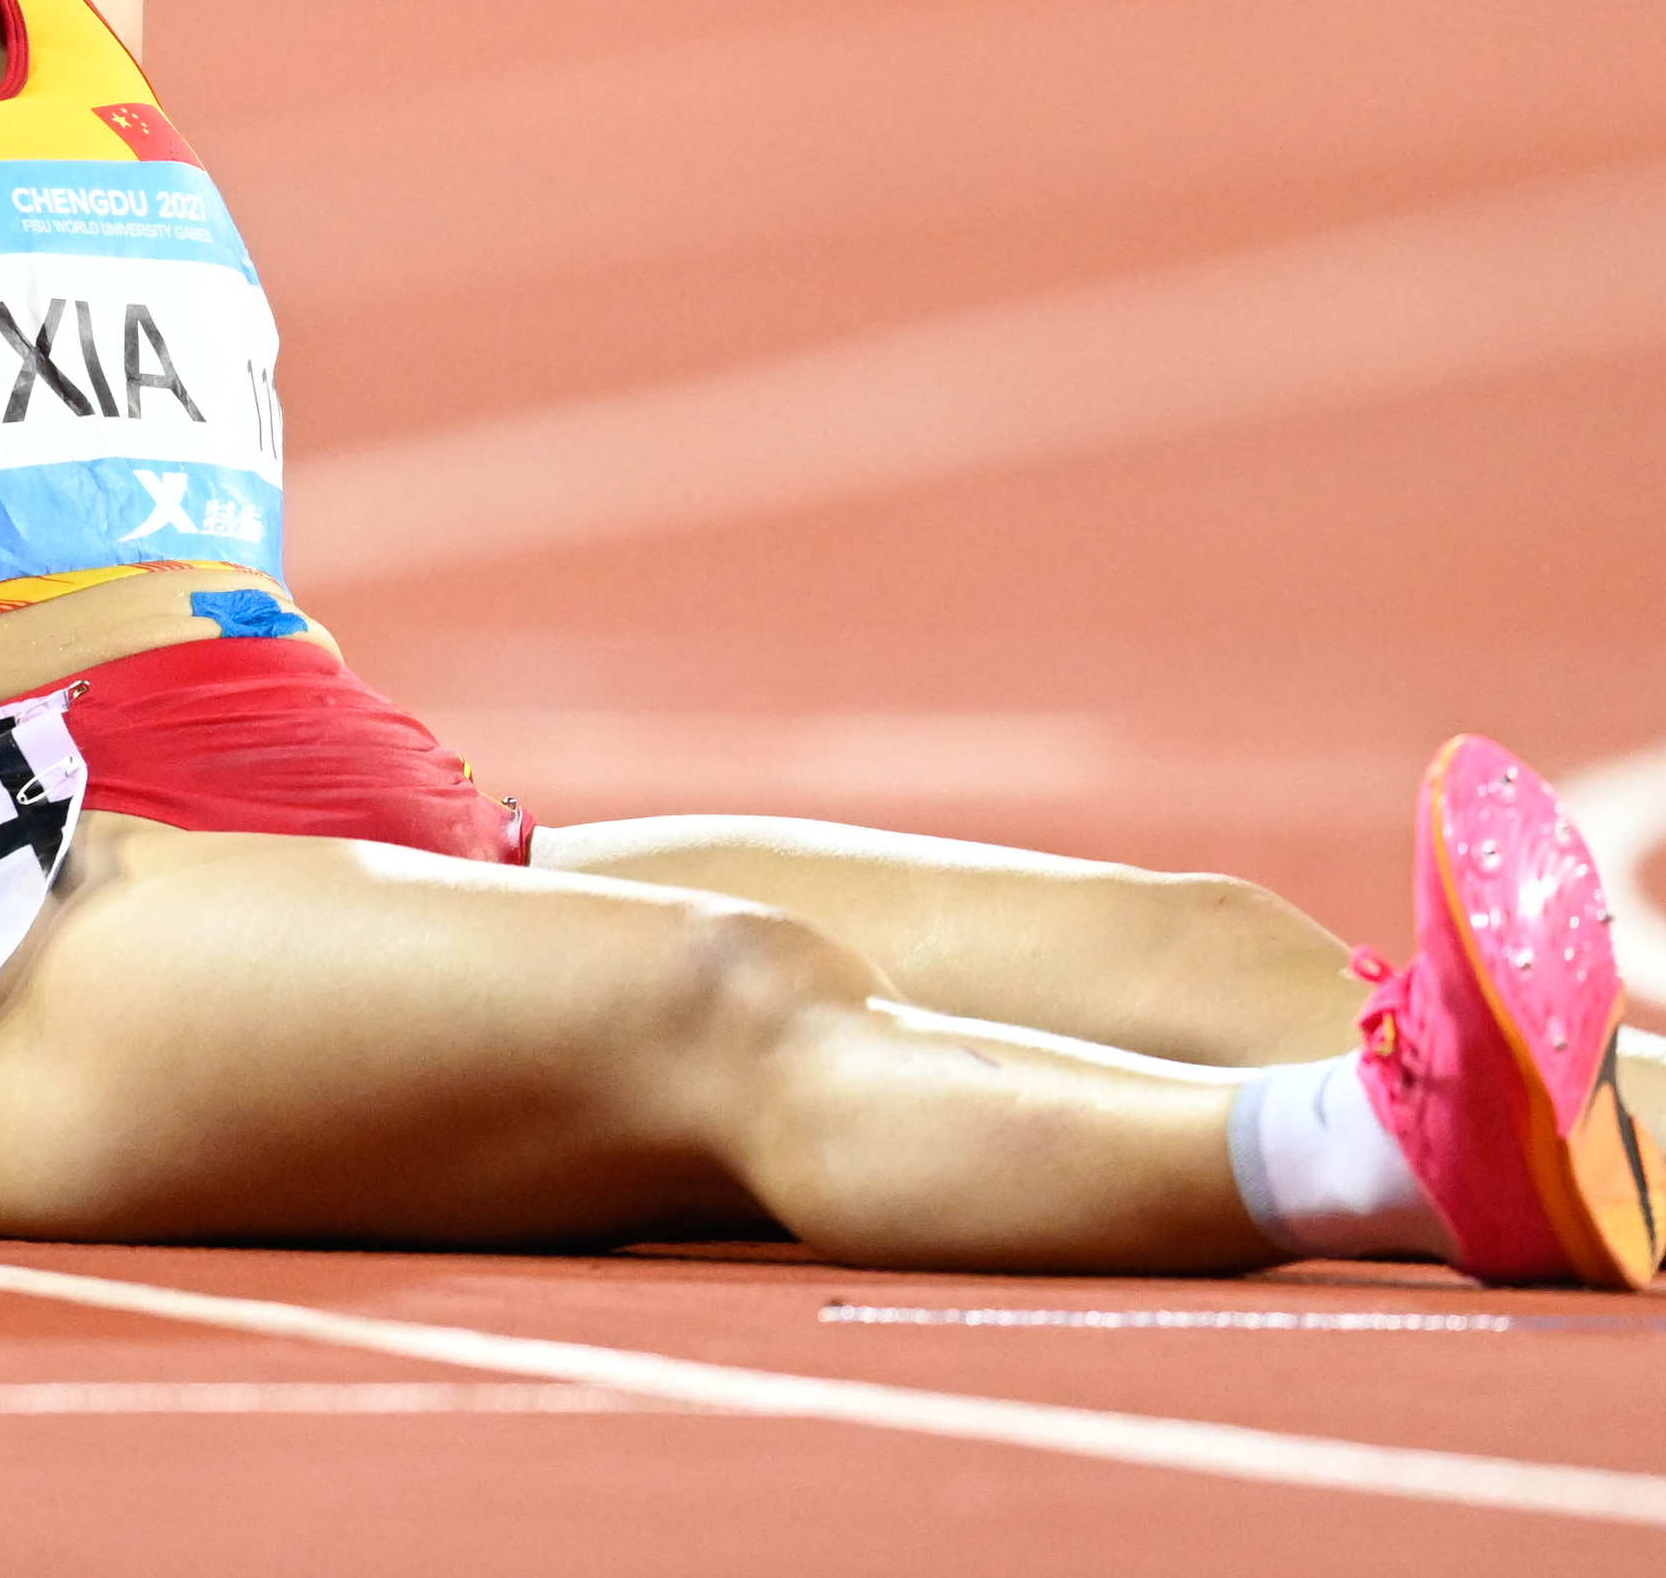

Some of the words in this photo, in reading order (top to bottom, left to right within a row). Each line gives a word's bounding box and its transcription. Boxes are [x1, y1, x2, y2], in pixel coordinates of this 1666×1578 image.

[11, 186, 148, 217] CHENGDU
[156, 190, 207, 222] 2021
[22, 219, 52, 234] FISU
[54, 221, 100, 236] WORLD
[101, 222, 171, 238] UNIVERSITY
[174, 225, 213, 243] GAMES
